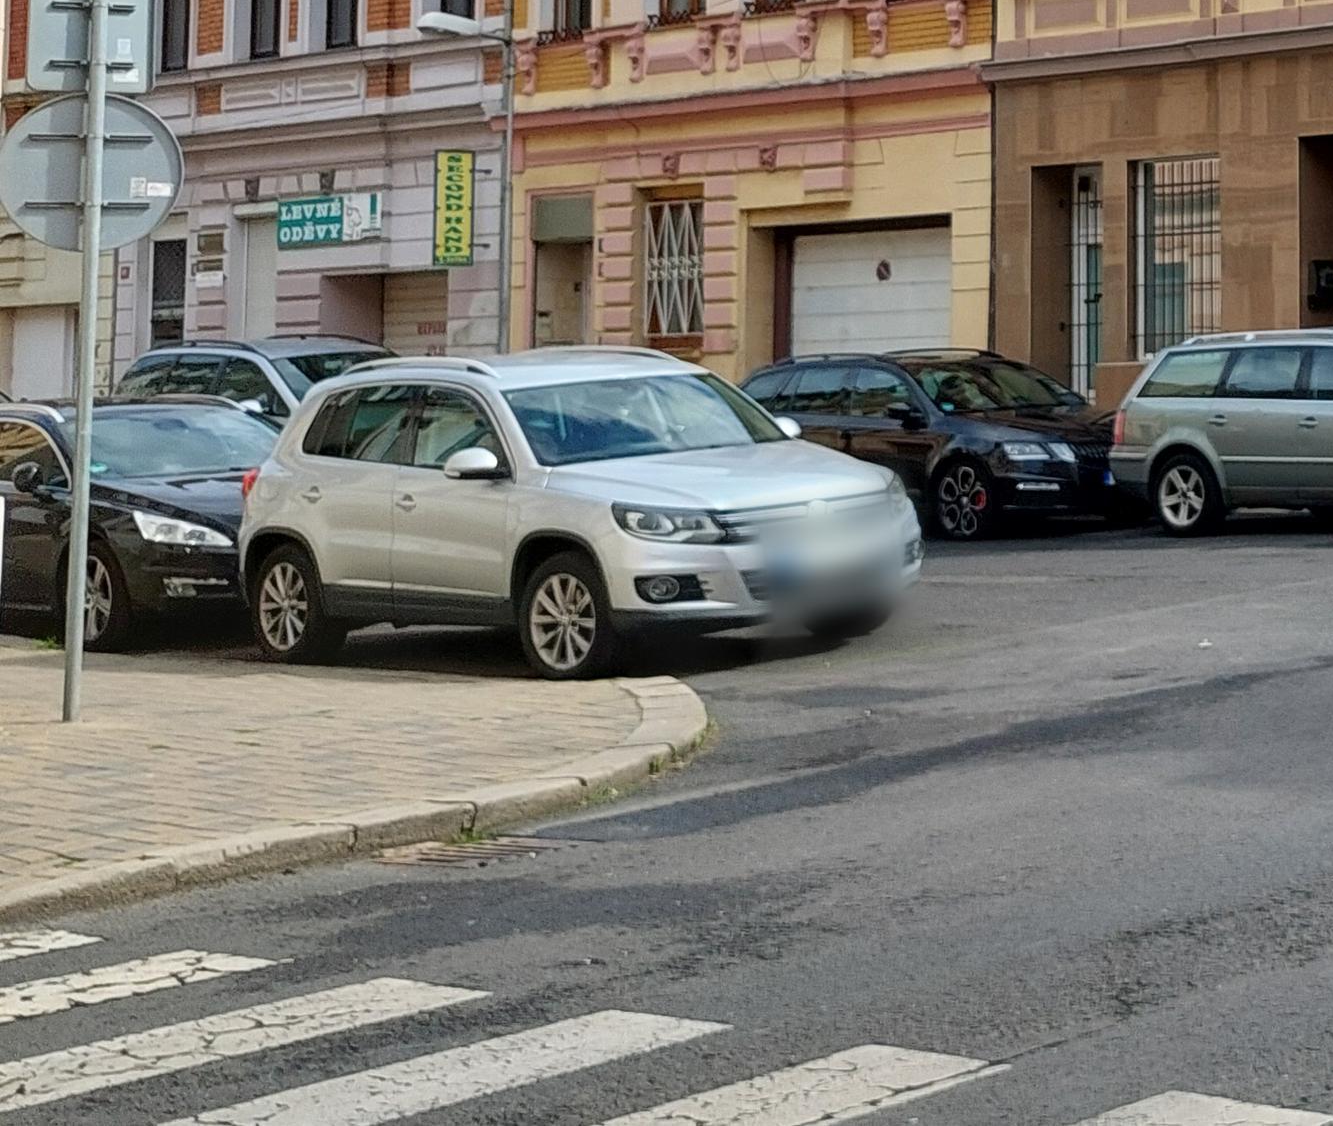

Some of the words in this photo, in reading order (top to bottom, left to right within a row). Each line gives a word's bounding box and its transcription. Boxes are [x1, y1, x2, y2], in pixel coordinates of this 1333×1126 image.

[445, 154, 464, 212] SECOND
[280, 199, 342, 221] LEVNÉ
[280, 221, 341, 243] ODĚVY
[444, 216, 464, 254] HAND
